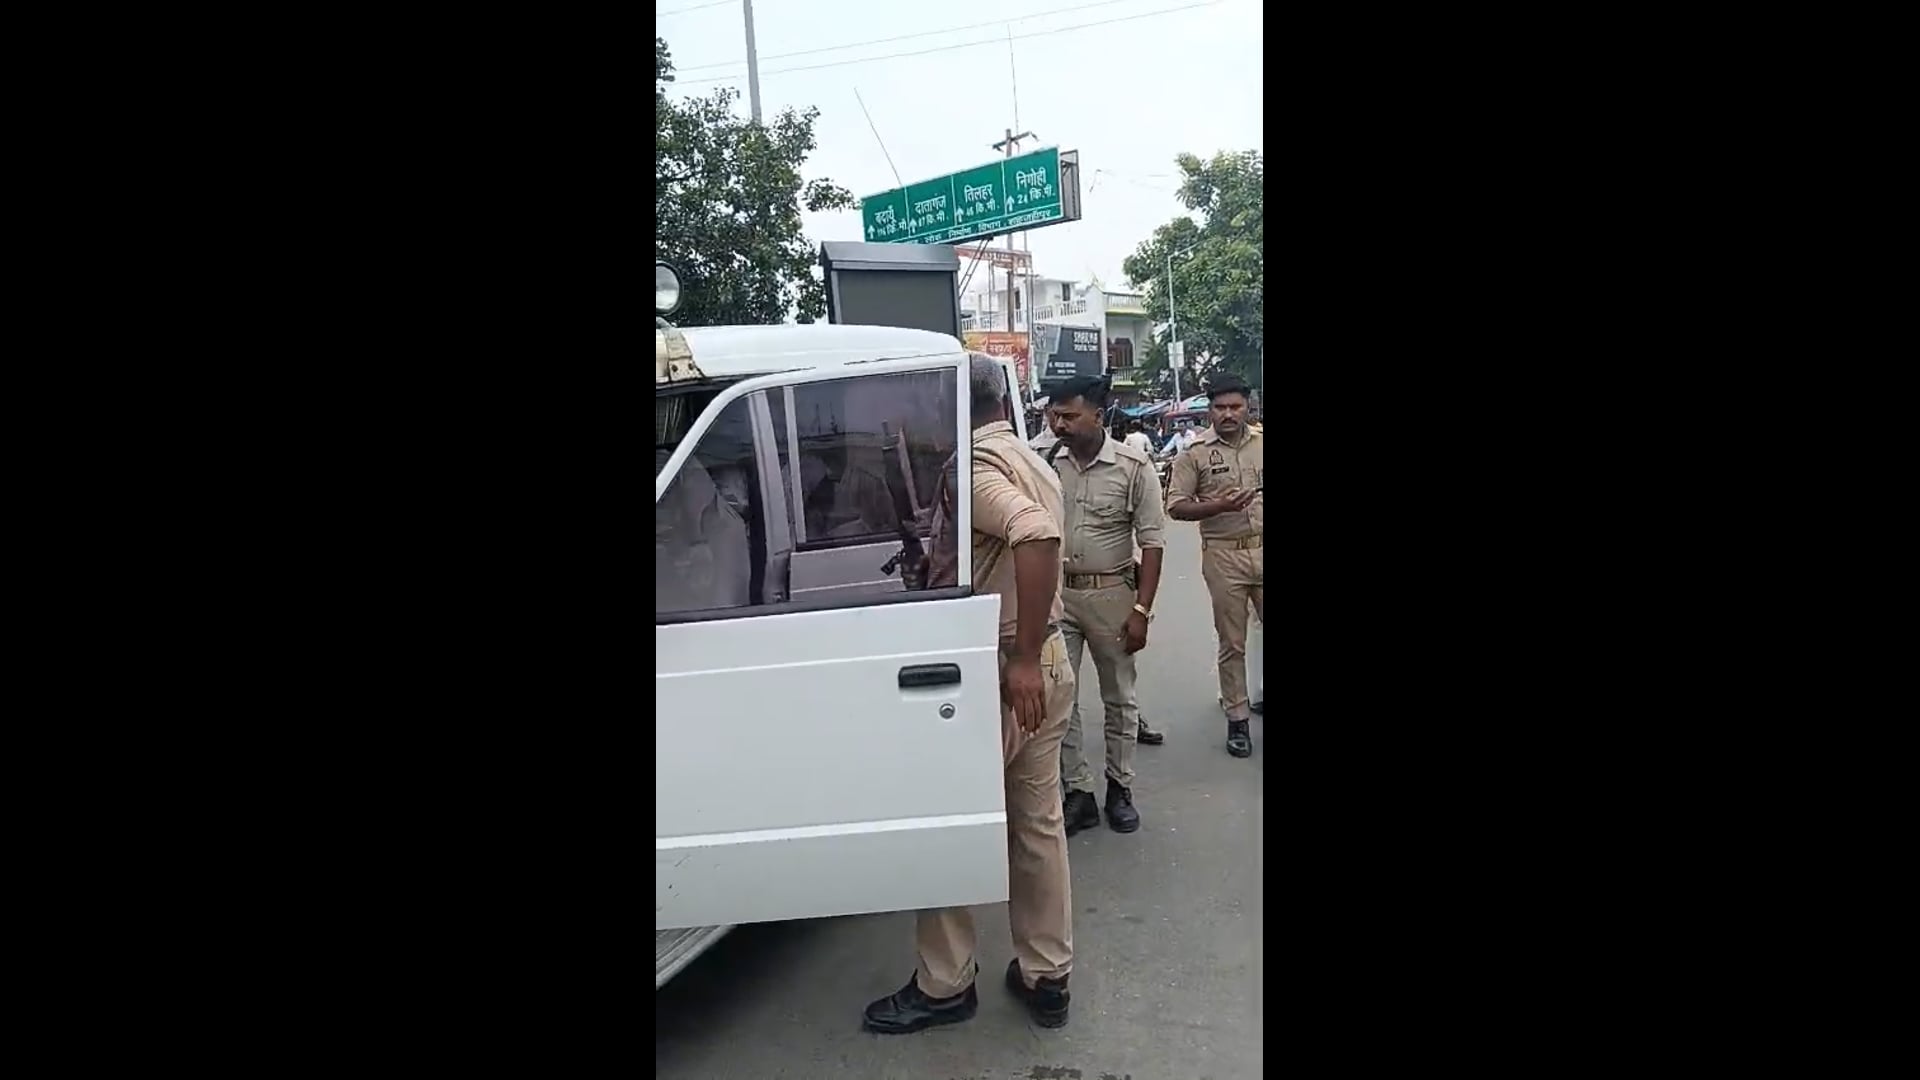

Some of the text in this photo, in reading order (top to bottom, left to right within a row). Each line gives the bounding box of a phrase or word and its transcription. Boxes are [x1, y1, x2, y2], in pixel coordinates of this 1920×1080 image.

[1016, 167, 1047, 191] निगोही
[914, 193, 946, 215] दातागंज
[964, 183, 993, 203] तिलहर
